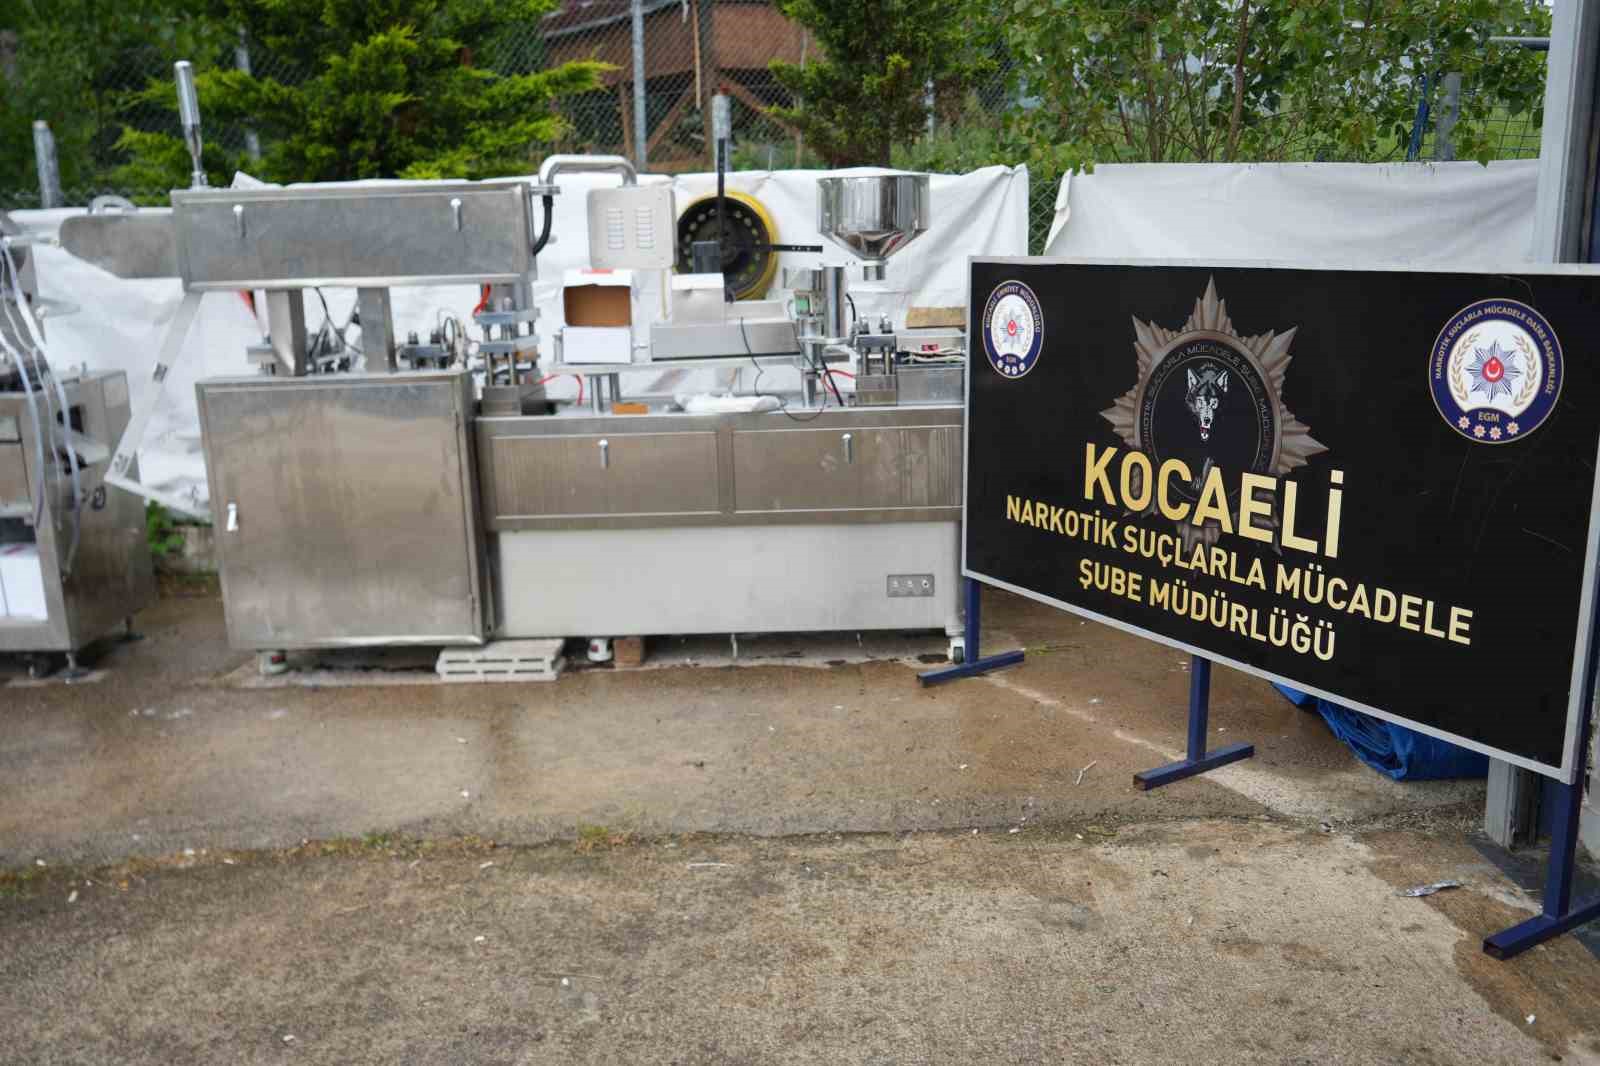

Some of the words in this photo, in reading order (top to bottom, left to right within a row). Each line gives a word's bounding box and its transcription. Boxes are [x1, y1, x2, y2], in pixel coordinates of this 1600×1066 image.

[1435, 338, 1452, 380] NARKOTİK
[1448, 309, 1483, 339] SUÇLARLA
[1484, 305, 1525, 320] MÜCADELE
[1478, 411, 1499, 423] EGM
[1084, 442, 1345, 558] KOCAELİ
[1006, 495, 1118, 549] NARKOTİK
[1122, 525, 1267, 590] SUÇLARLA
[1275, 563, 1474, 646] MÜCADELE
[1078, 559, 1143, 602] ŞUBE
[1149, 579, 1336, 661] MÜDÜRLÜĞÜ
